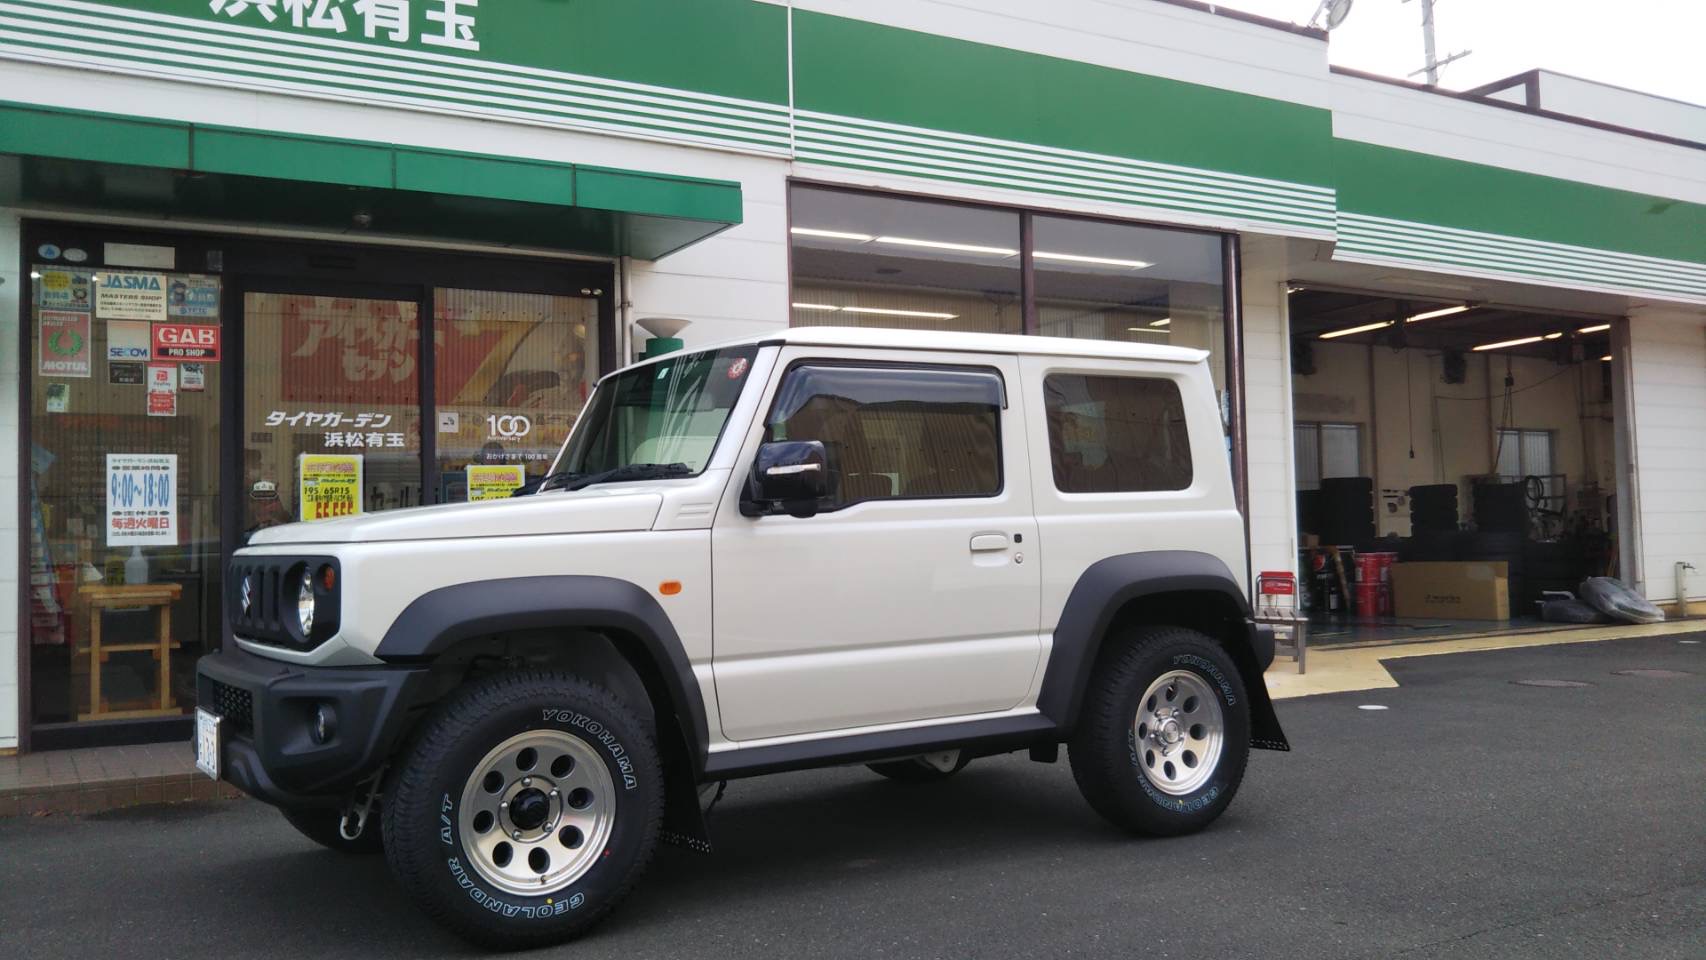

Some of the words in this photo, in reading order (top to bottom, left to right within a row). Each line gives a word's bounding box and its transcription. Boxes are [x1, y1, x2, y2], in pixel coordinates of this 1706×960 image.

[100, 274, 161, 291] JASMA
[100, 293, 139, 301] MASTERS
[158, 327, 215, 344] GAB
[110, 347, 148, 357] SECOM
[169, 348, 184, 356] PRO
[186, 349, 206, 357] SHOP
[43, 361, 88, 371] MOTUL
[265, 410, 392, 428] タイヤガーデン
[486, 414, 531, 437] 100
[324, 431, 405, 448] 浜松有玉
[111, 517, 170, 530] 毎週火曜日
[541, 709, 638, 790] YOKOHAMA
[440, 793, 454, 846] A/T
[448, 856, 585, 919] GEOLANDAR
